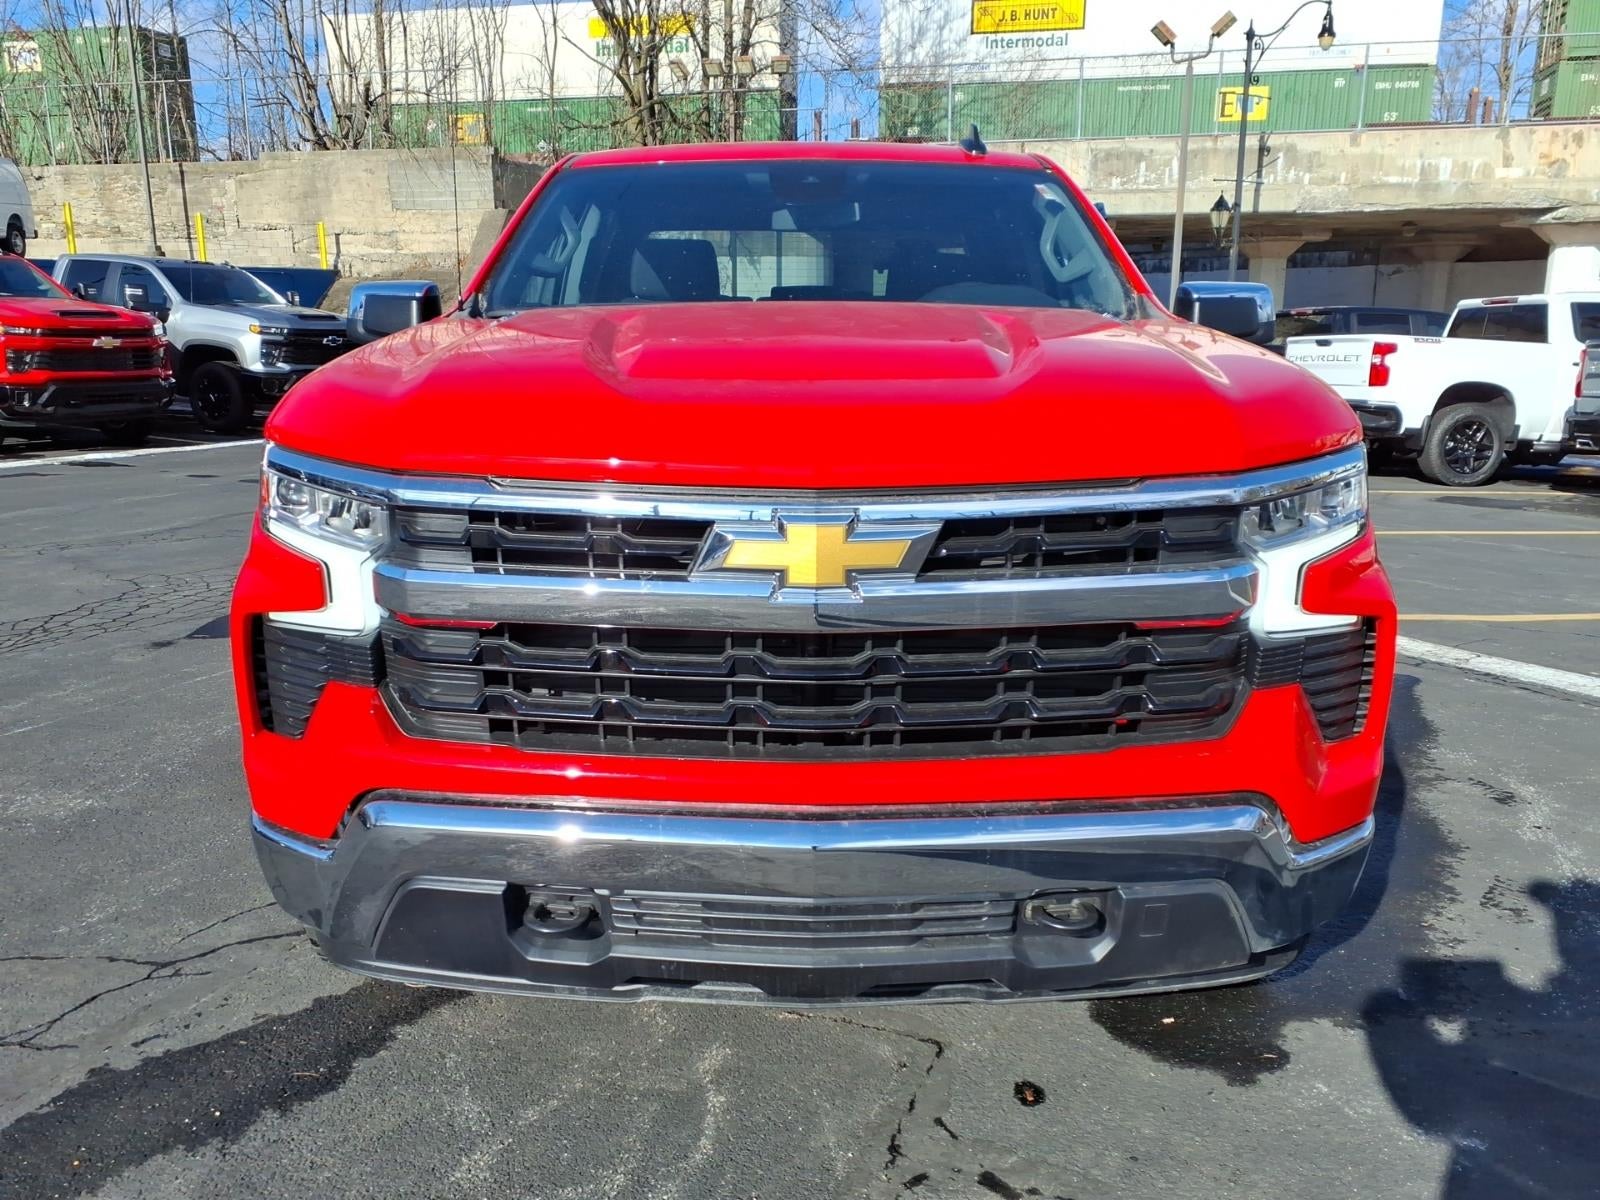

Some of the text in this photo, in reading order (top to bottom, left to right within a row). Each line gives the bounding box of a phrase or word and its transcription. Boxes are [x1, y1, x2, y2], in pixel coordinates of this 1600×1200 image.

[1024, 8, 1057, 20] HUNT
[596, 38, 689, 57] Intdal
[985, 33, 1068, 49] Intermodal
[1288, 354, 1362, 363] CHEVROLET
